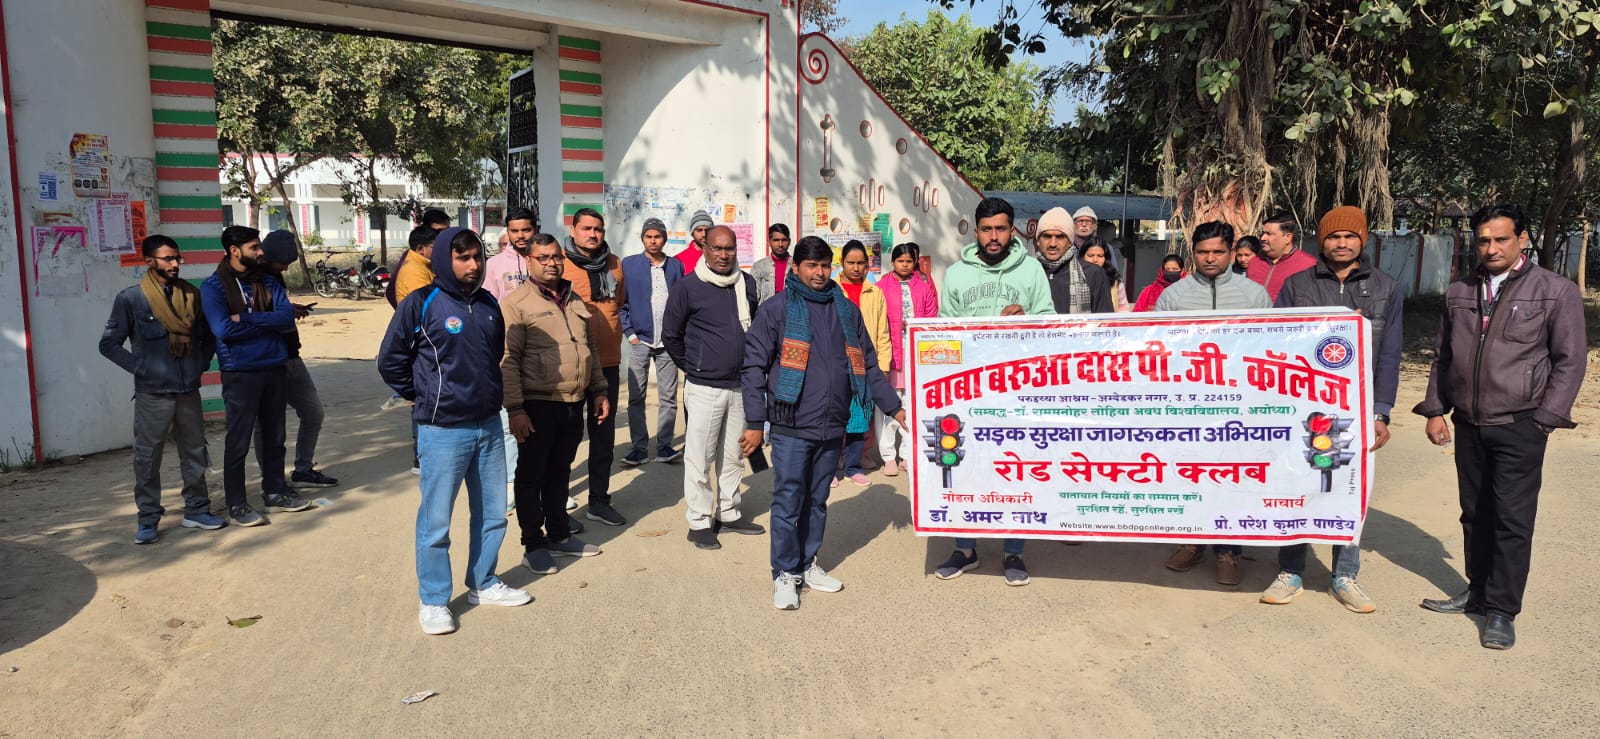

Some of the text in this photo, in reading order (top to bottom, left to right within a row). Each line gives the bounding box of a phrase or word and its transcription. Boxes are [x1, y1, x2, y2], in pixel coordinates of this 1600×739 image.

[922, 366, 984, 410] बाबा
[985, 353, 1072, 393] बरुआ
[1073, 350, 1133, 382] दास
[1243, 349, 1352, 411] कॉलेज
[1144, 393, 1171, 403] नगर,
[1175, 393, 1185, 402] उ.
[1189, 393, 1200, 402] प्र.
[1204, 394, 1242, 402] 224159
[1032, 405, 1087, 418] राममनोहर
[1091, 405, 1130, 418] लोहिया
[1134, 406, 1162, 416] अवध
[973, 420, 1292, 449] सड़क सुरक्षा जागरूकता अभियान
[993, 451, 1271, 485] रोड सेफ्टी क्लब
[942, 490, 1033, 505] नोडल अधिकारी
[1101, 490, 1130, 500] नियमों
[1133, 493, 1145, 501] का
[1262, 495, 1305, 508] प्राचार्य
[929, 505, 952, 522] डॉ.
[962, 509, 1004, 524] अमर
[1077, 504, 1110, 515] सुरक्षित
[1130, 505, 1164, 516] सुरक्षित
[1167, 505, 1185, 515] रखें
[1214, 515, 1356, 535] प्रो. परेश कुमार पाण्डेय
